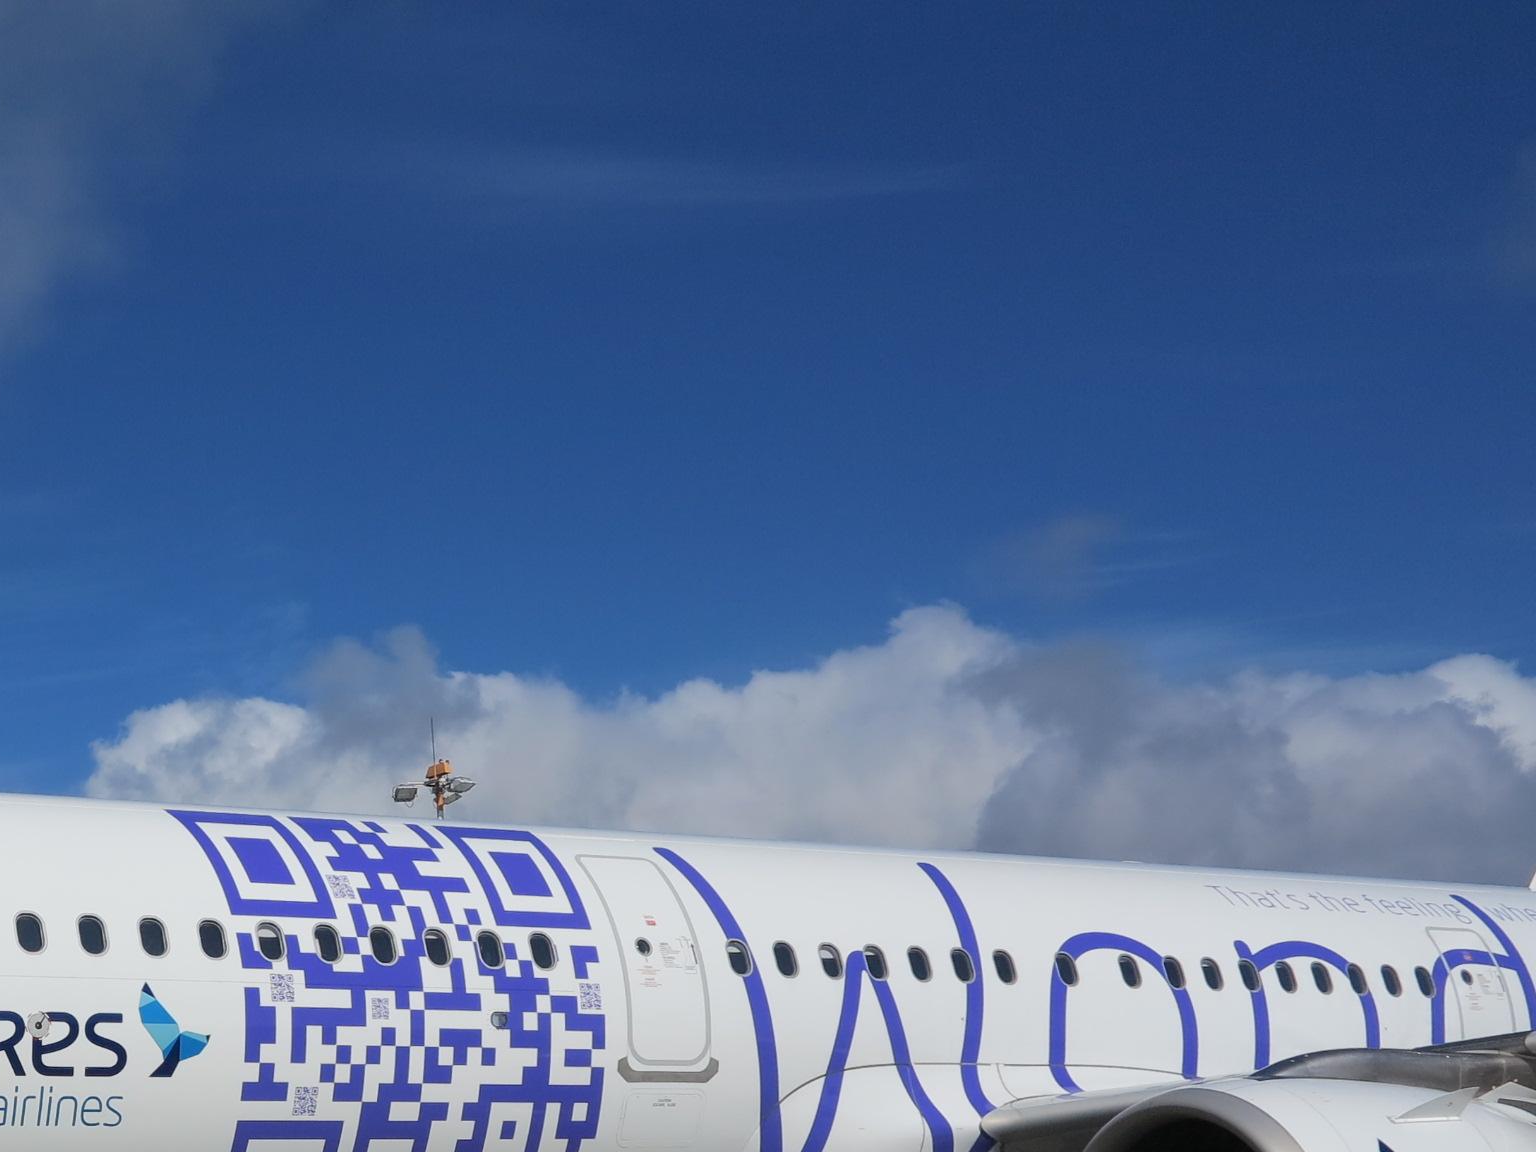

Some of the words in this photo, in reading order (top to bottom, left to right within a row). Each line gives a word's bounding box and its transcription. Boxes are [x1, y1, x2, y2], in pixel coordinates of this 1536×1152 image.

[1203, 885, 1310, 910] That's
[1308, 891, 1367, 914] the
[1362, 894, 1473, 925] feeling
